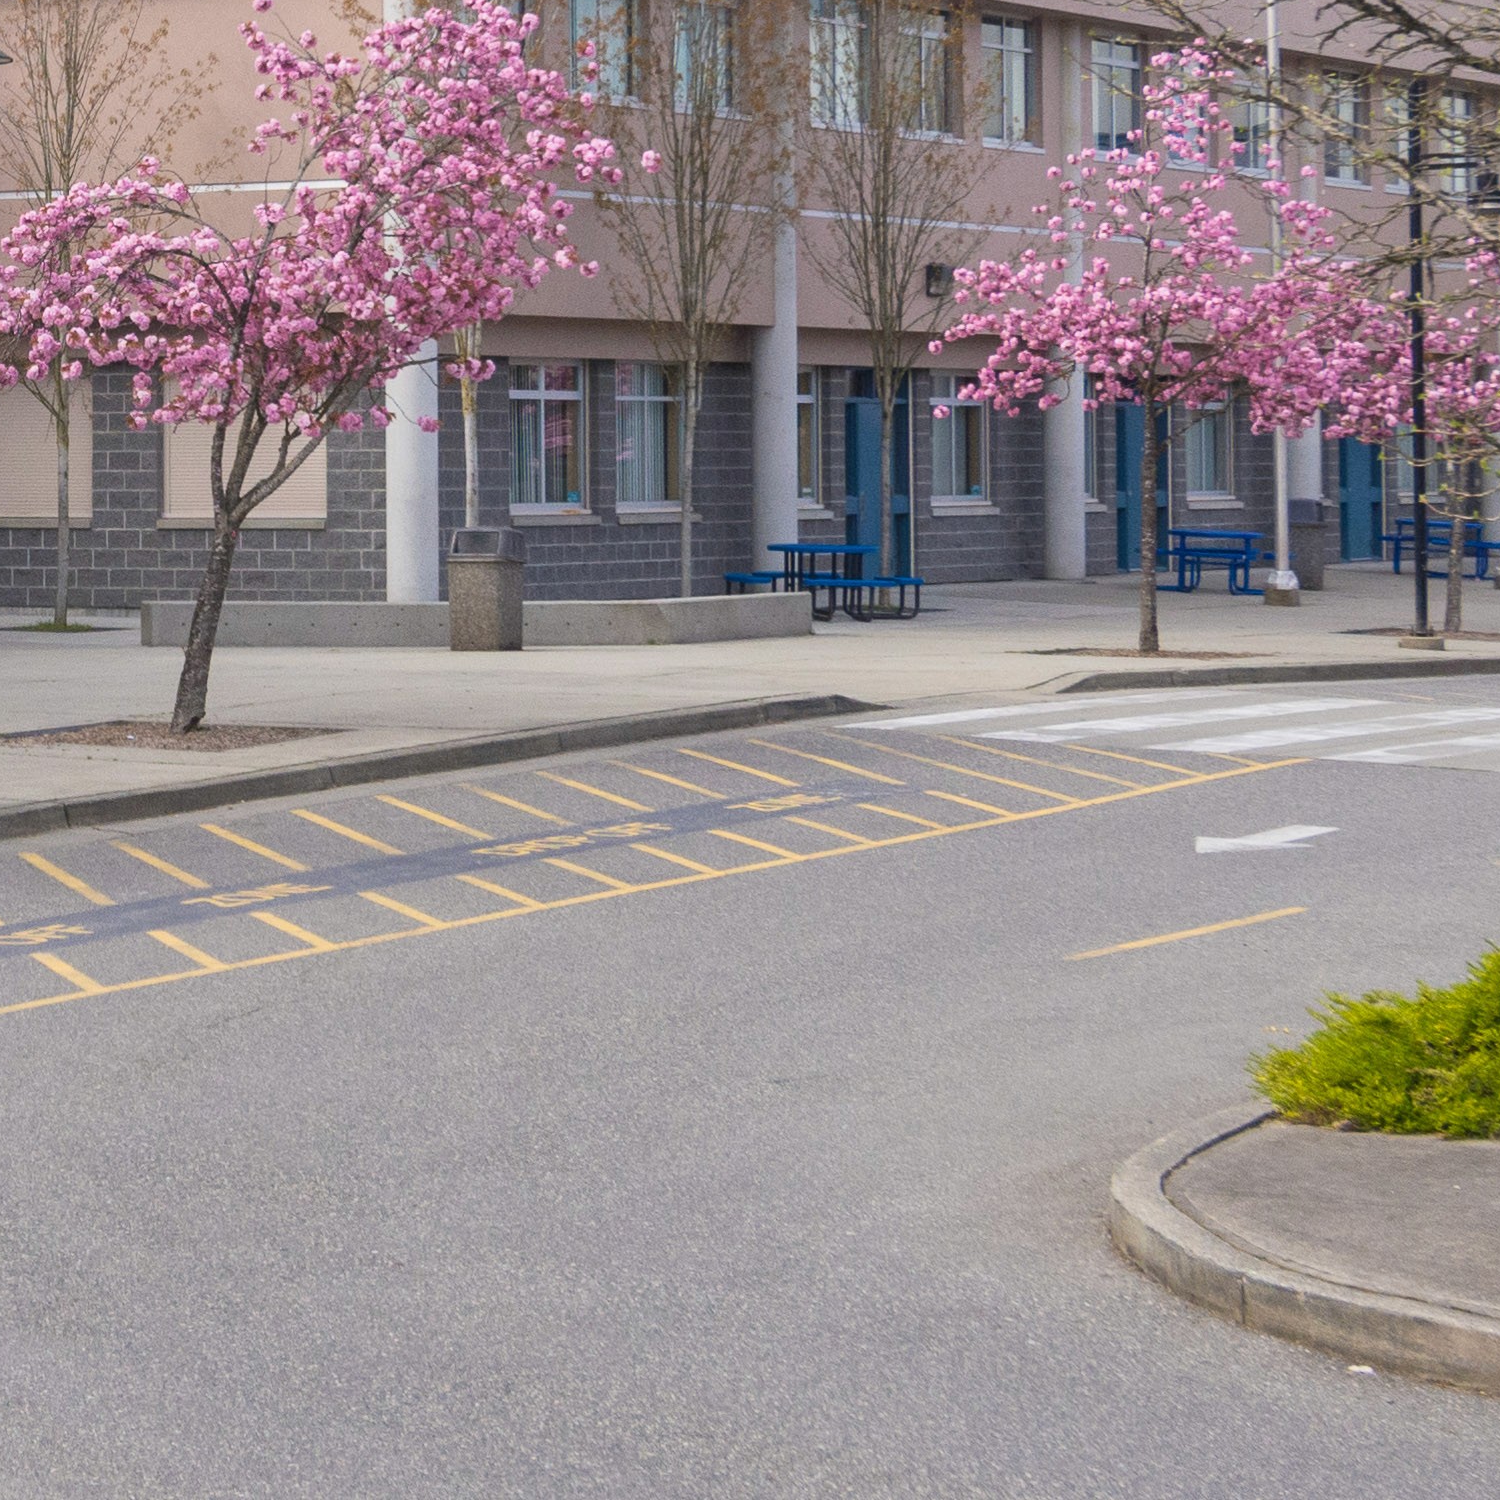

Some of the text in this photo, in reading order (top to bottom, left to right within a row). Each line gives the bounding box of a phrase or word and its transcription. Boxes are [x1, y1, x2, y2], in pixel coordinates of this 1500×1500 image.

[472, 793, 843, 856] DROP OFF ZONE
[180, 882, 334, 908] ZONE
